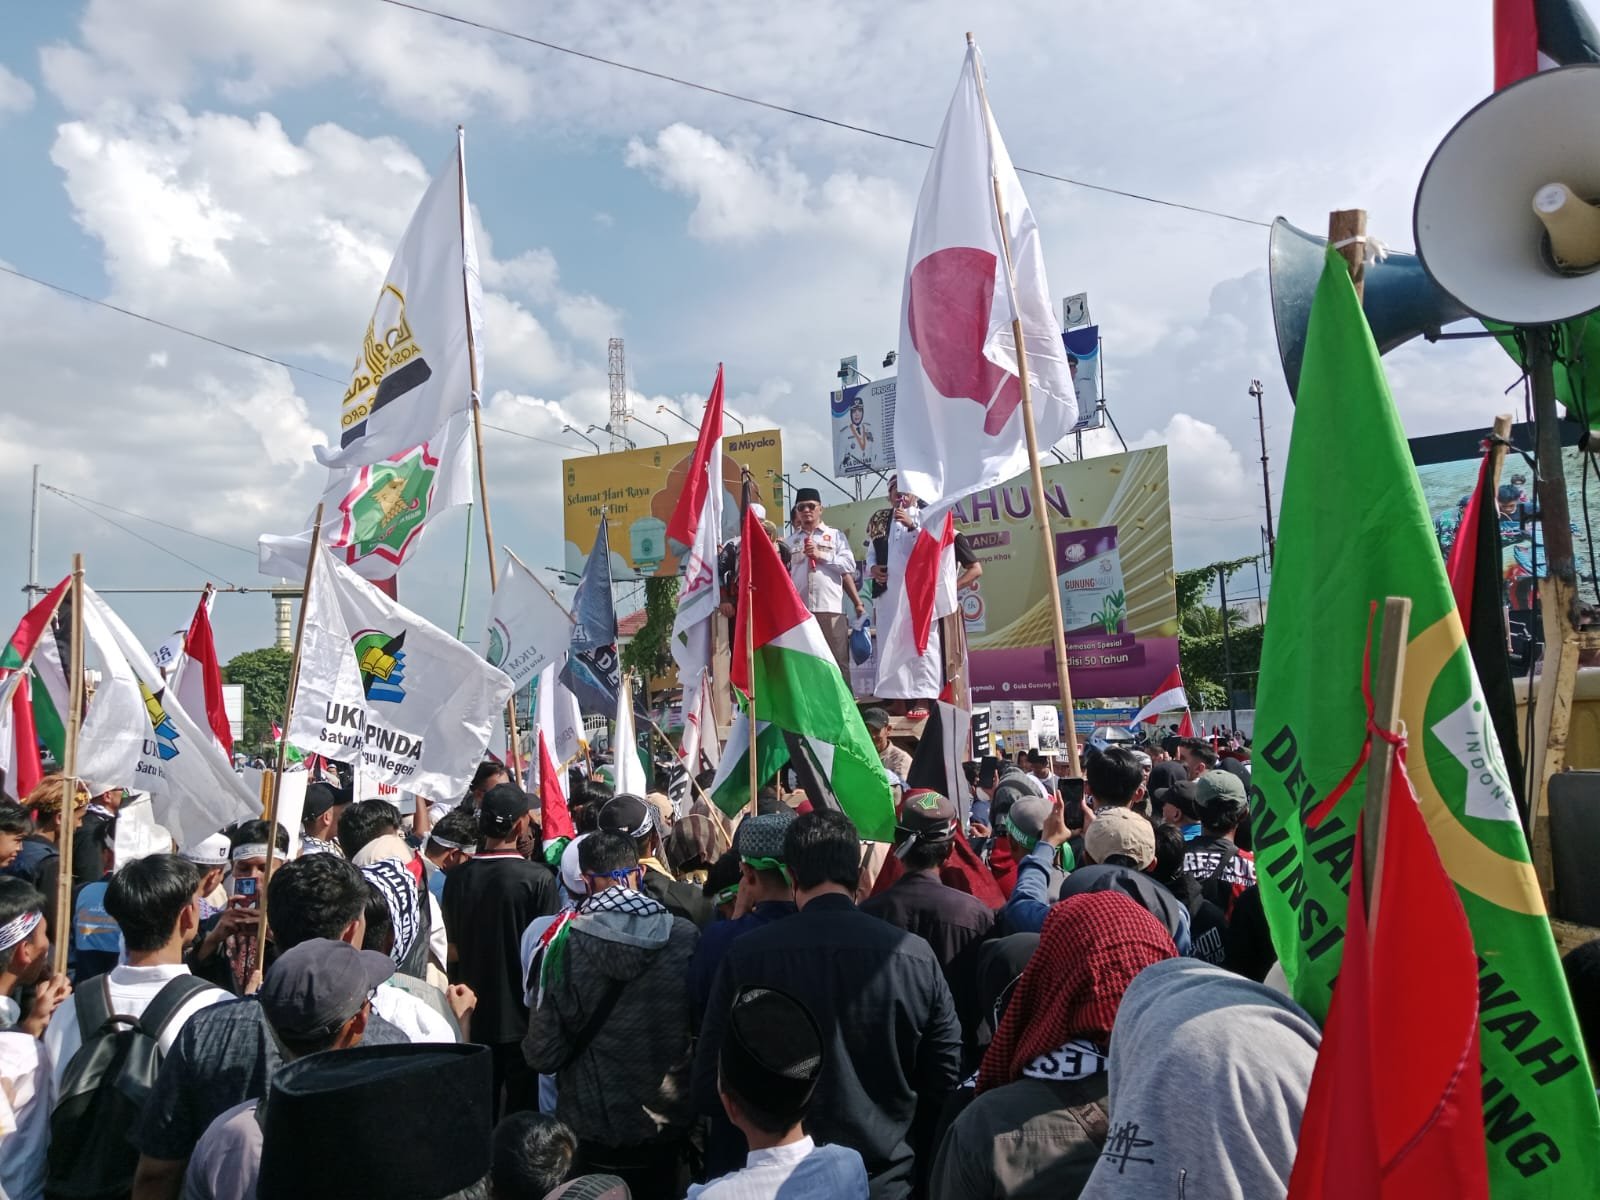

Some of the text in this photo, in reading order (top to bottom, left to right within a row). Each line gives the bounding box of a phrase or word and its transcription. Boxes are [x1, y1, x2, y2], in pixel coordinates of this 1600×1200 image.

[738, 437, 776, 451] Miyako
[567, 486, 650, 506] Selamat Hari Raya
[609, 503, 628, 514] Fitri
[951, 484, 1072, 524] AHUN
[1097, 639, 1122, 649] Spesial
[1067, 653, 1129, 666] disi 50 Tahun
[319, 727, 352, 746] Satu
[378, 754, 417, 776] Negeri
[365, 723, 422, 761] PINDA
[135, 760, 157, 777] Satu
[1464, 730, 1514, 811] INDONE
[1260, 724, 1356, 897] DEWA
[1250, 783, 1345, 962] OVINSI
